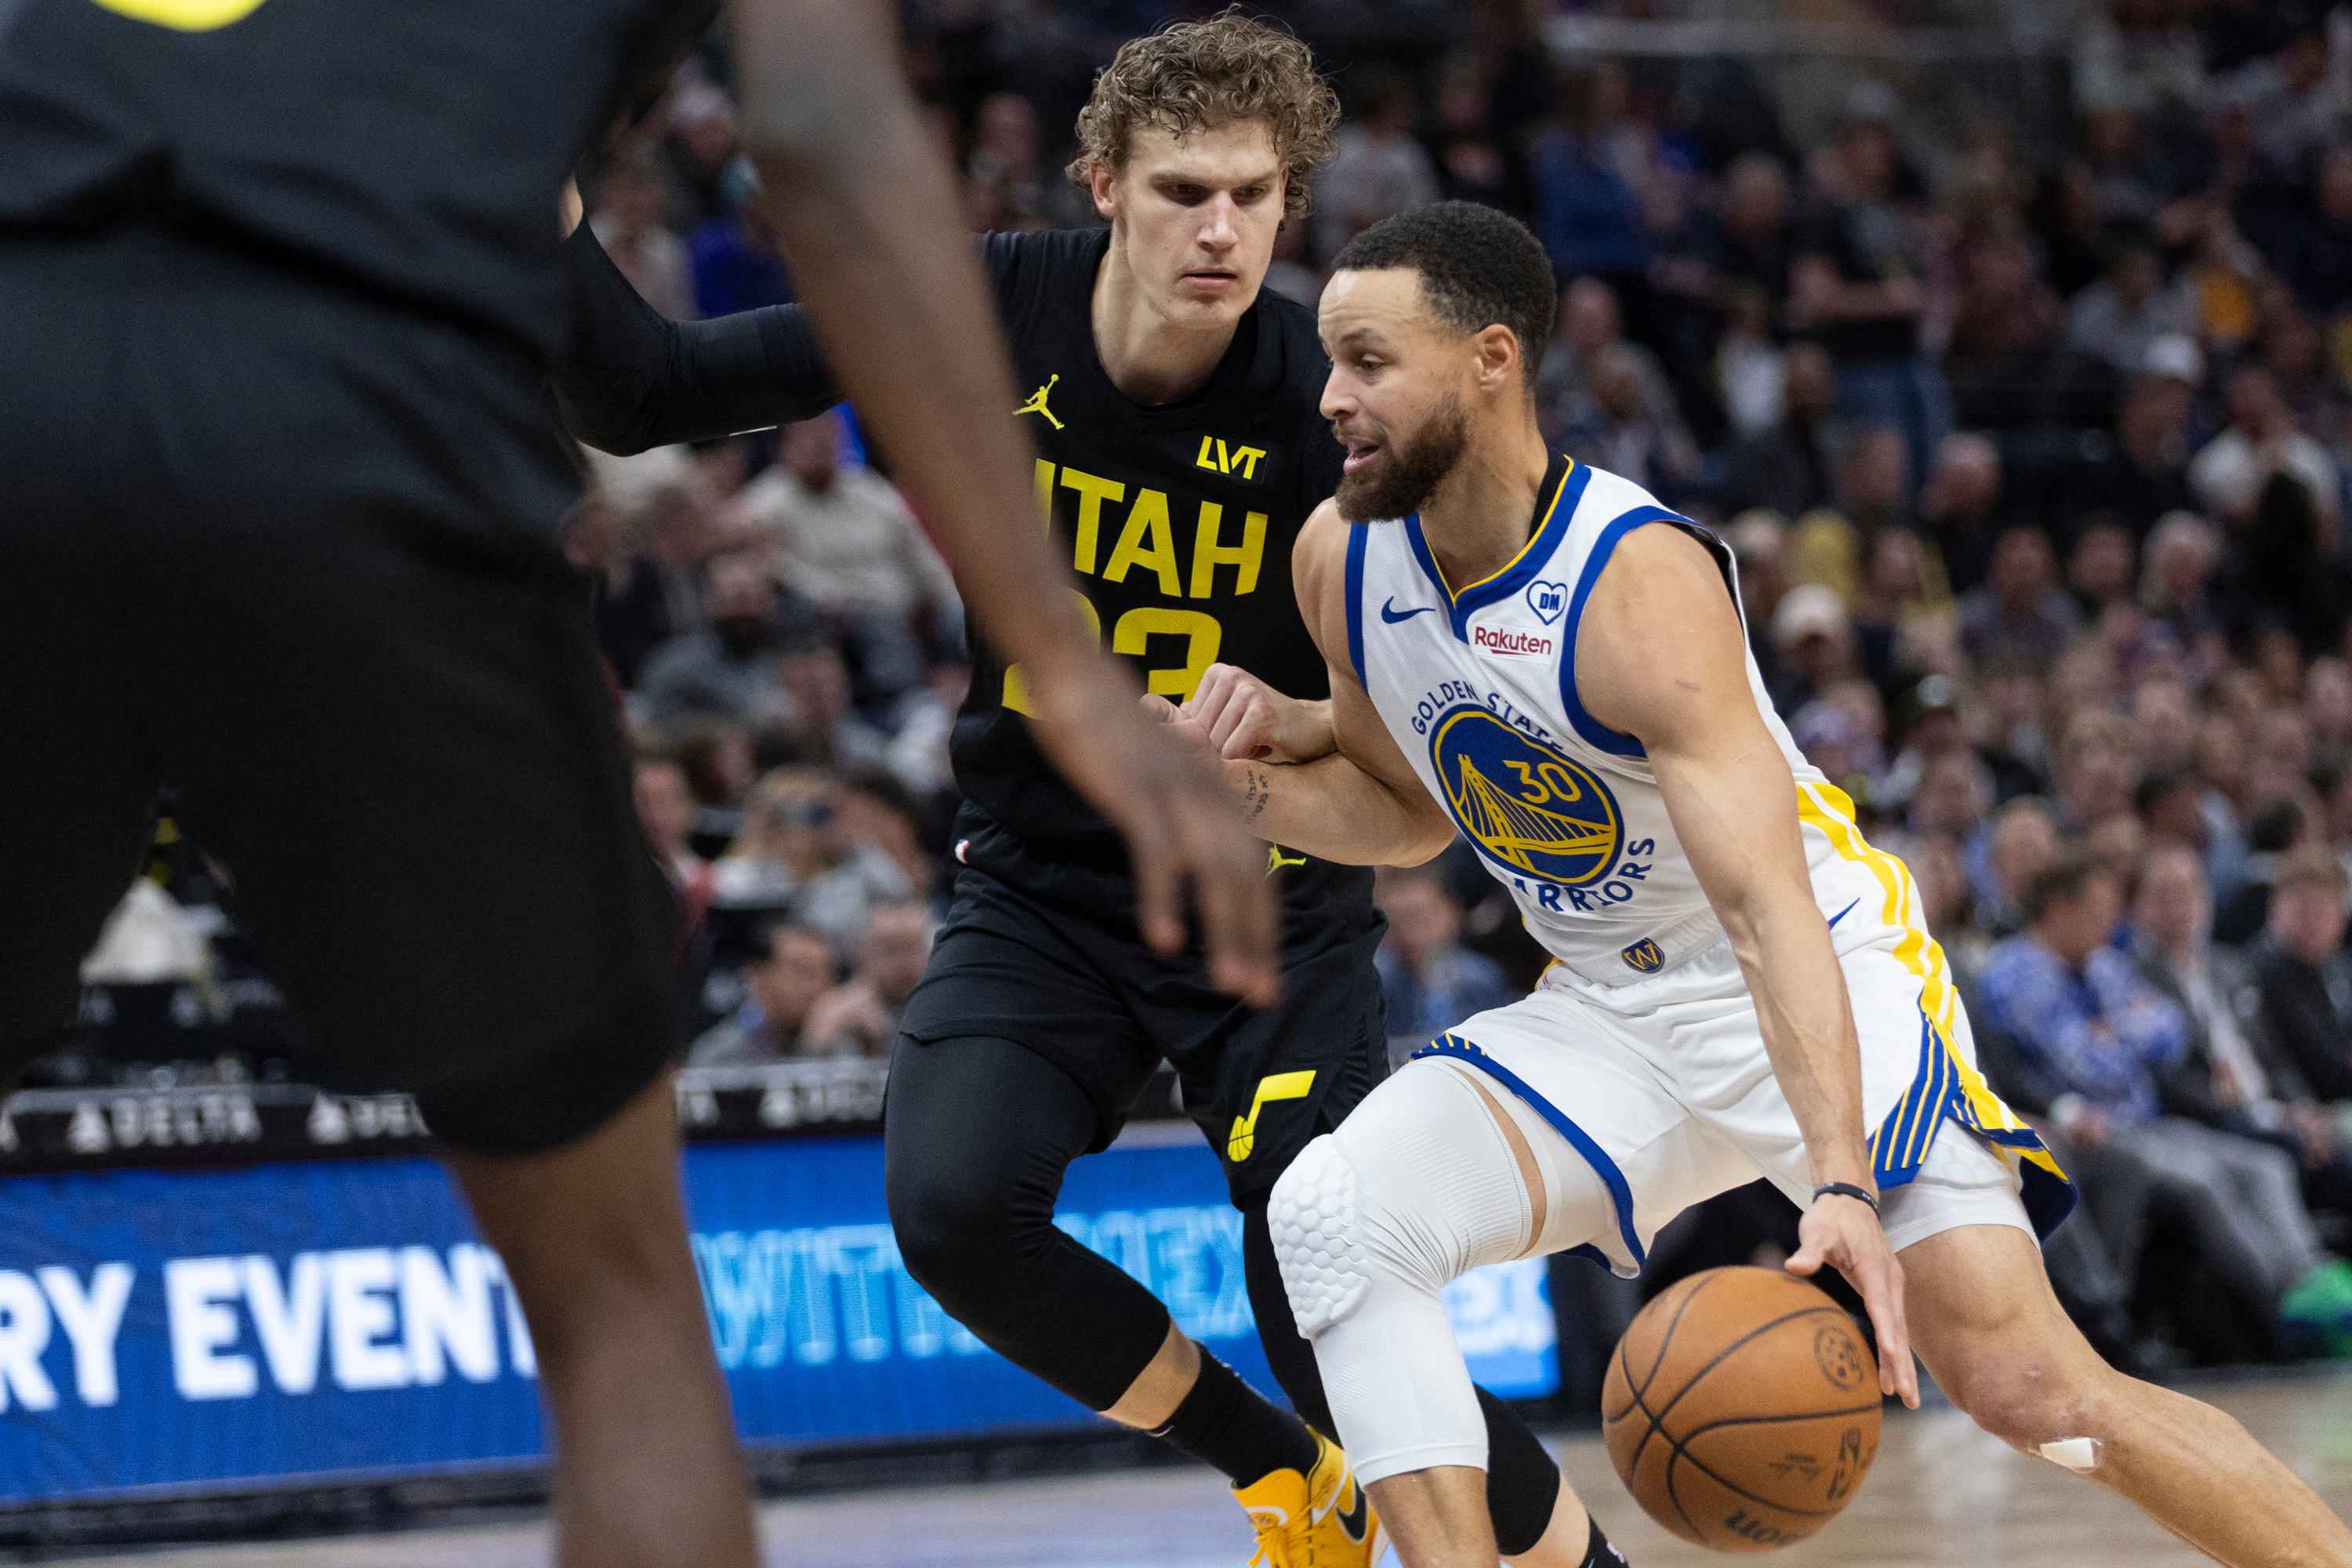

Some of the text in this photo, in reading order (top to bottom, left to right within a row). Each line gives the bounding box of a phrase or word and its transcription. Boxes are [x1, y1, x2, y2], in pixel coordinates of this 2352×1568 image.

[1196, 435, 1268, 480] LVT
[1538, 592, 1561, 612] DM
[1474, 626, 1552, 655] Rakuten
[1411, 680, 1481, 735] GOLDEN
[1503, 760, 1581, 804] 30
[1624, 942, 1660, 971] W
